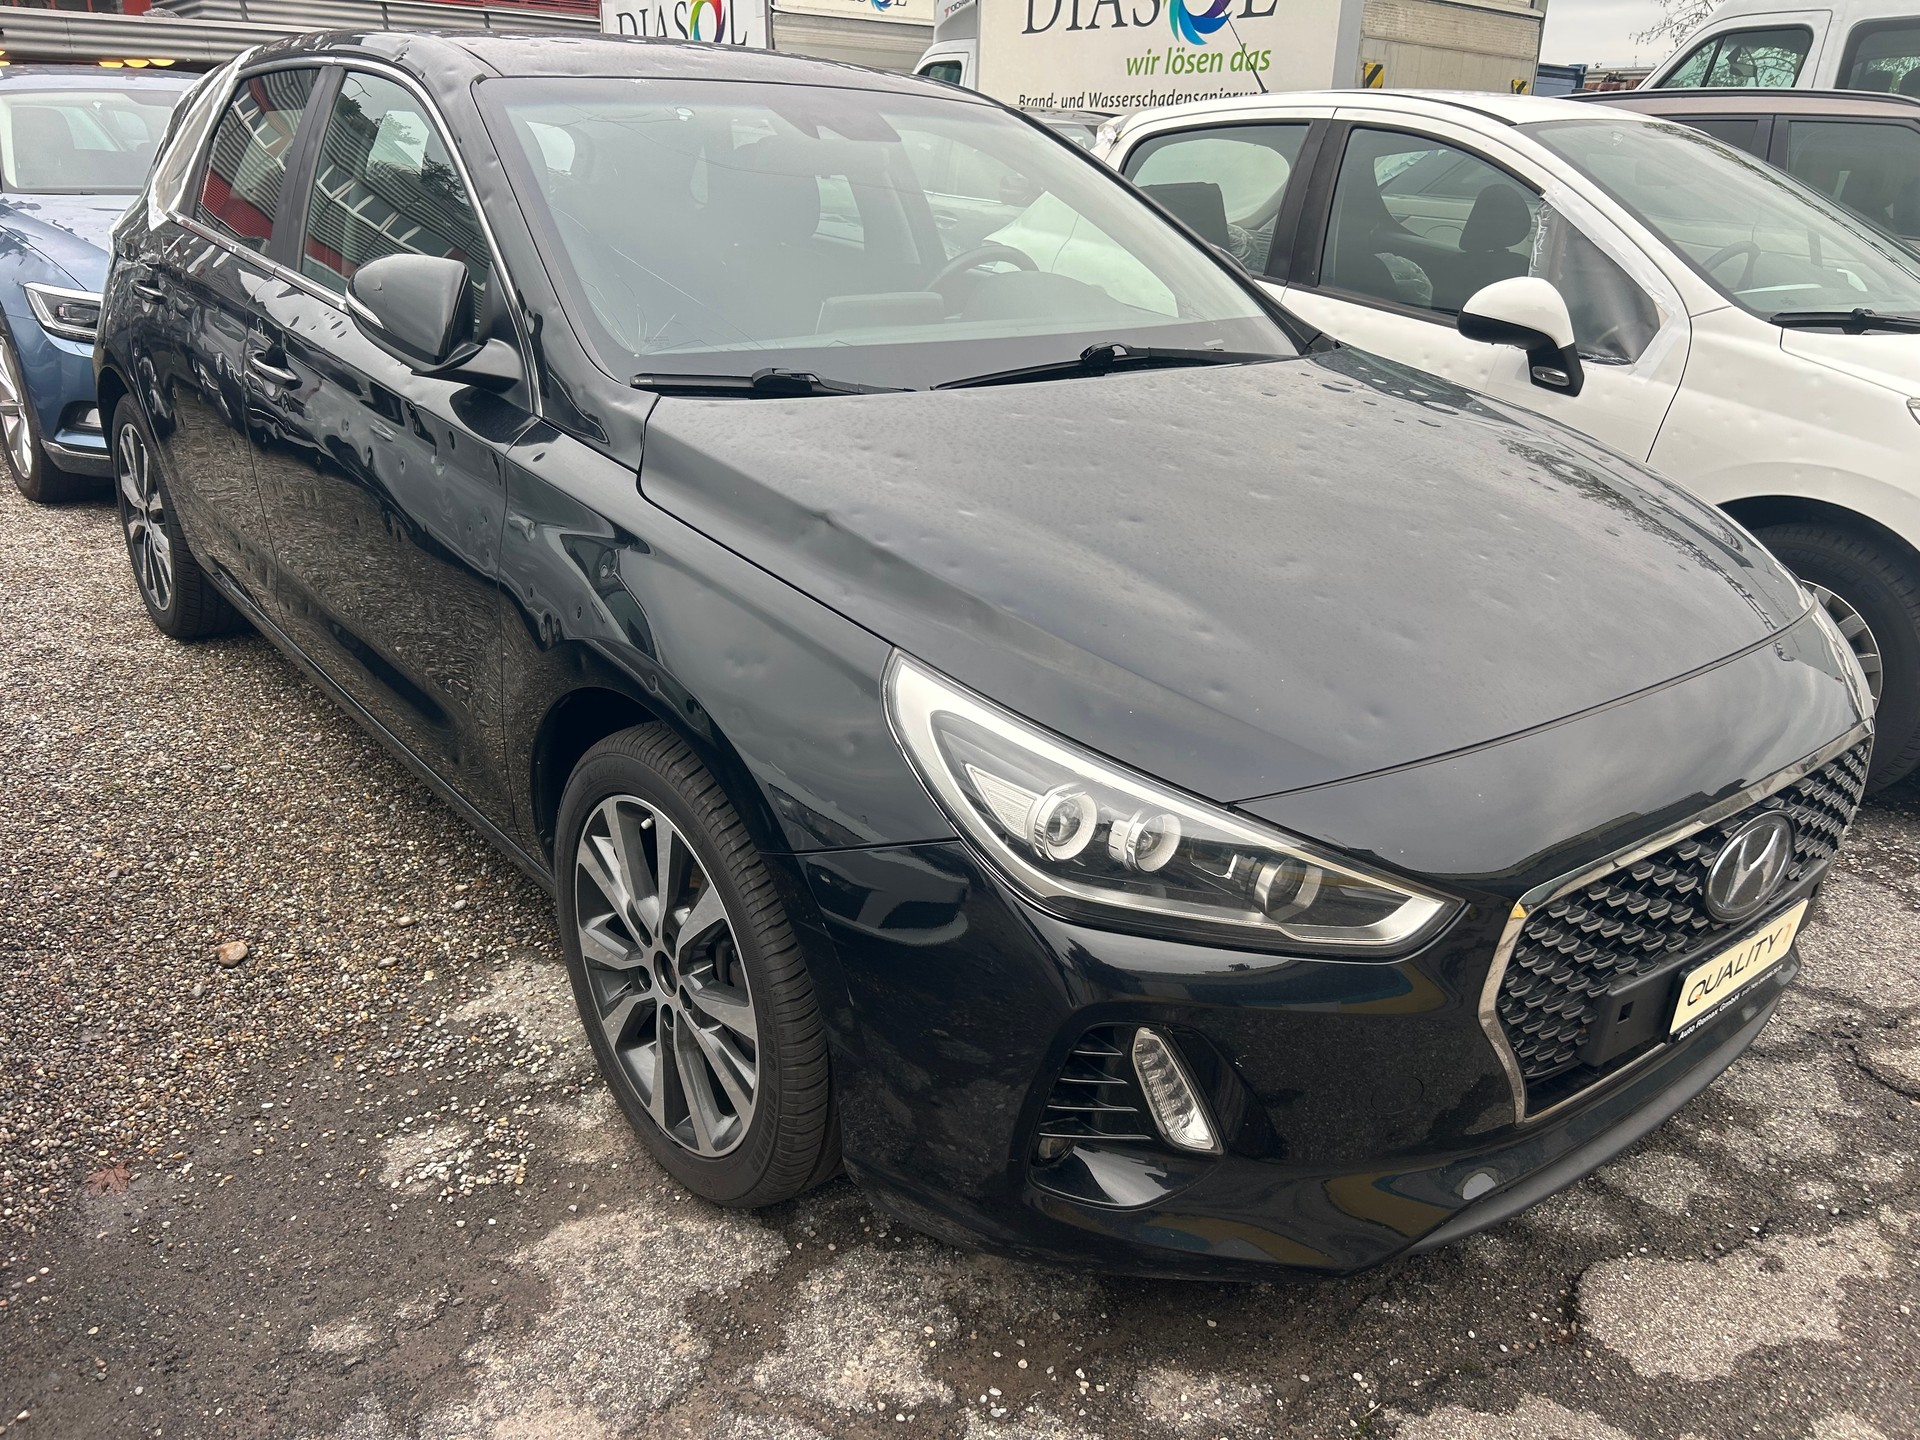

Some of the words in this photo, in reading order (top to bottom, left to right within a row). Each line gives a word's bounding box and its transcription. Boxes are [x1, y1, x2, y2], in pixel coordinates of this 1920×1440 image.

[1126, 48, 1161, 76] wir
[1165, 46, 1224, 75] lösen
[1229, 43, 1272, 73] das
[1018, 92, 1058, 108] Brand-
[1060, 91, 1085, 108] und
[1678, 1024, 1696, 1041] Auto
